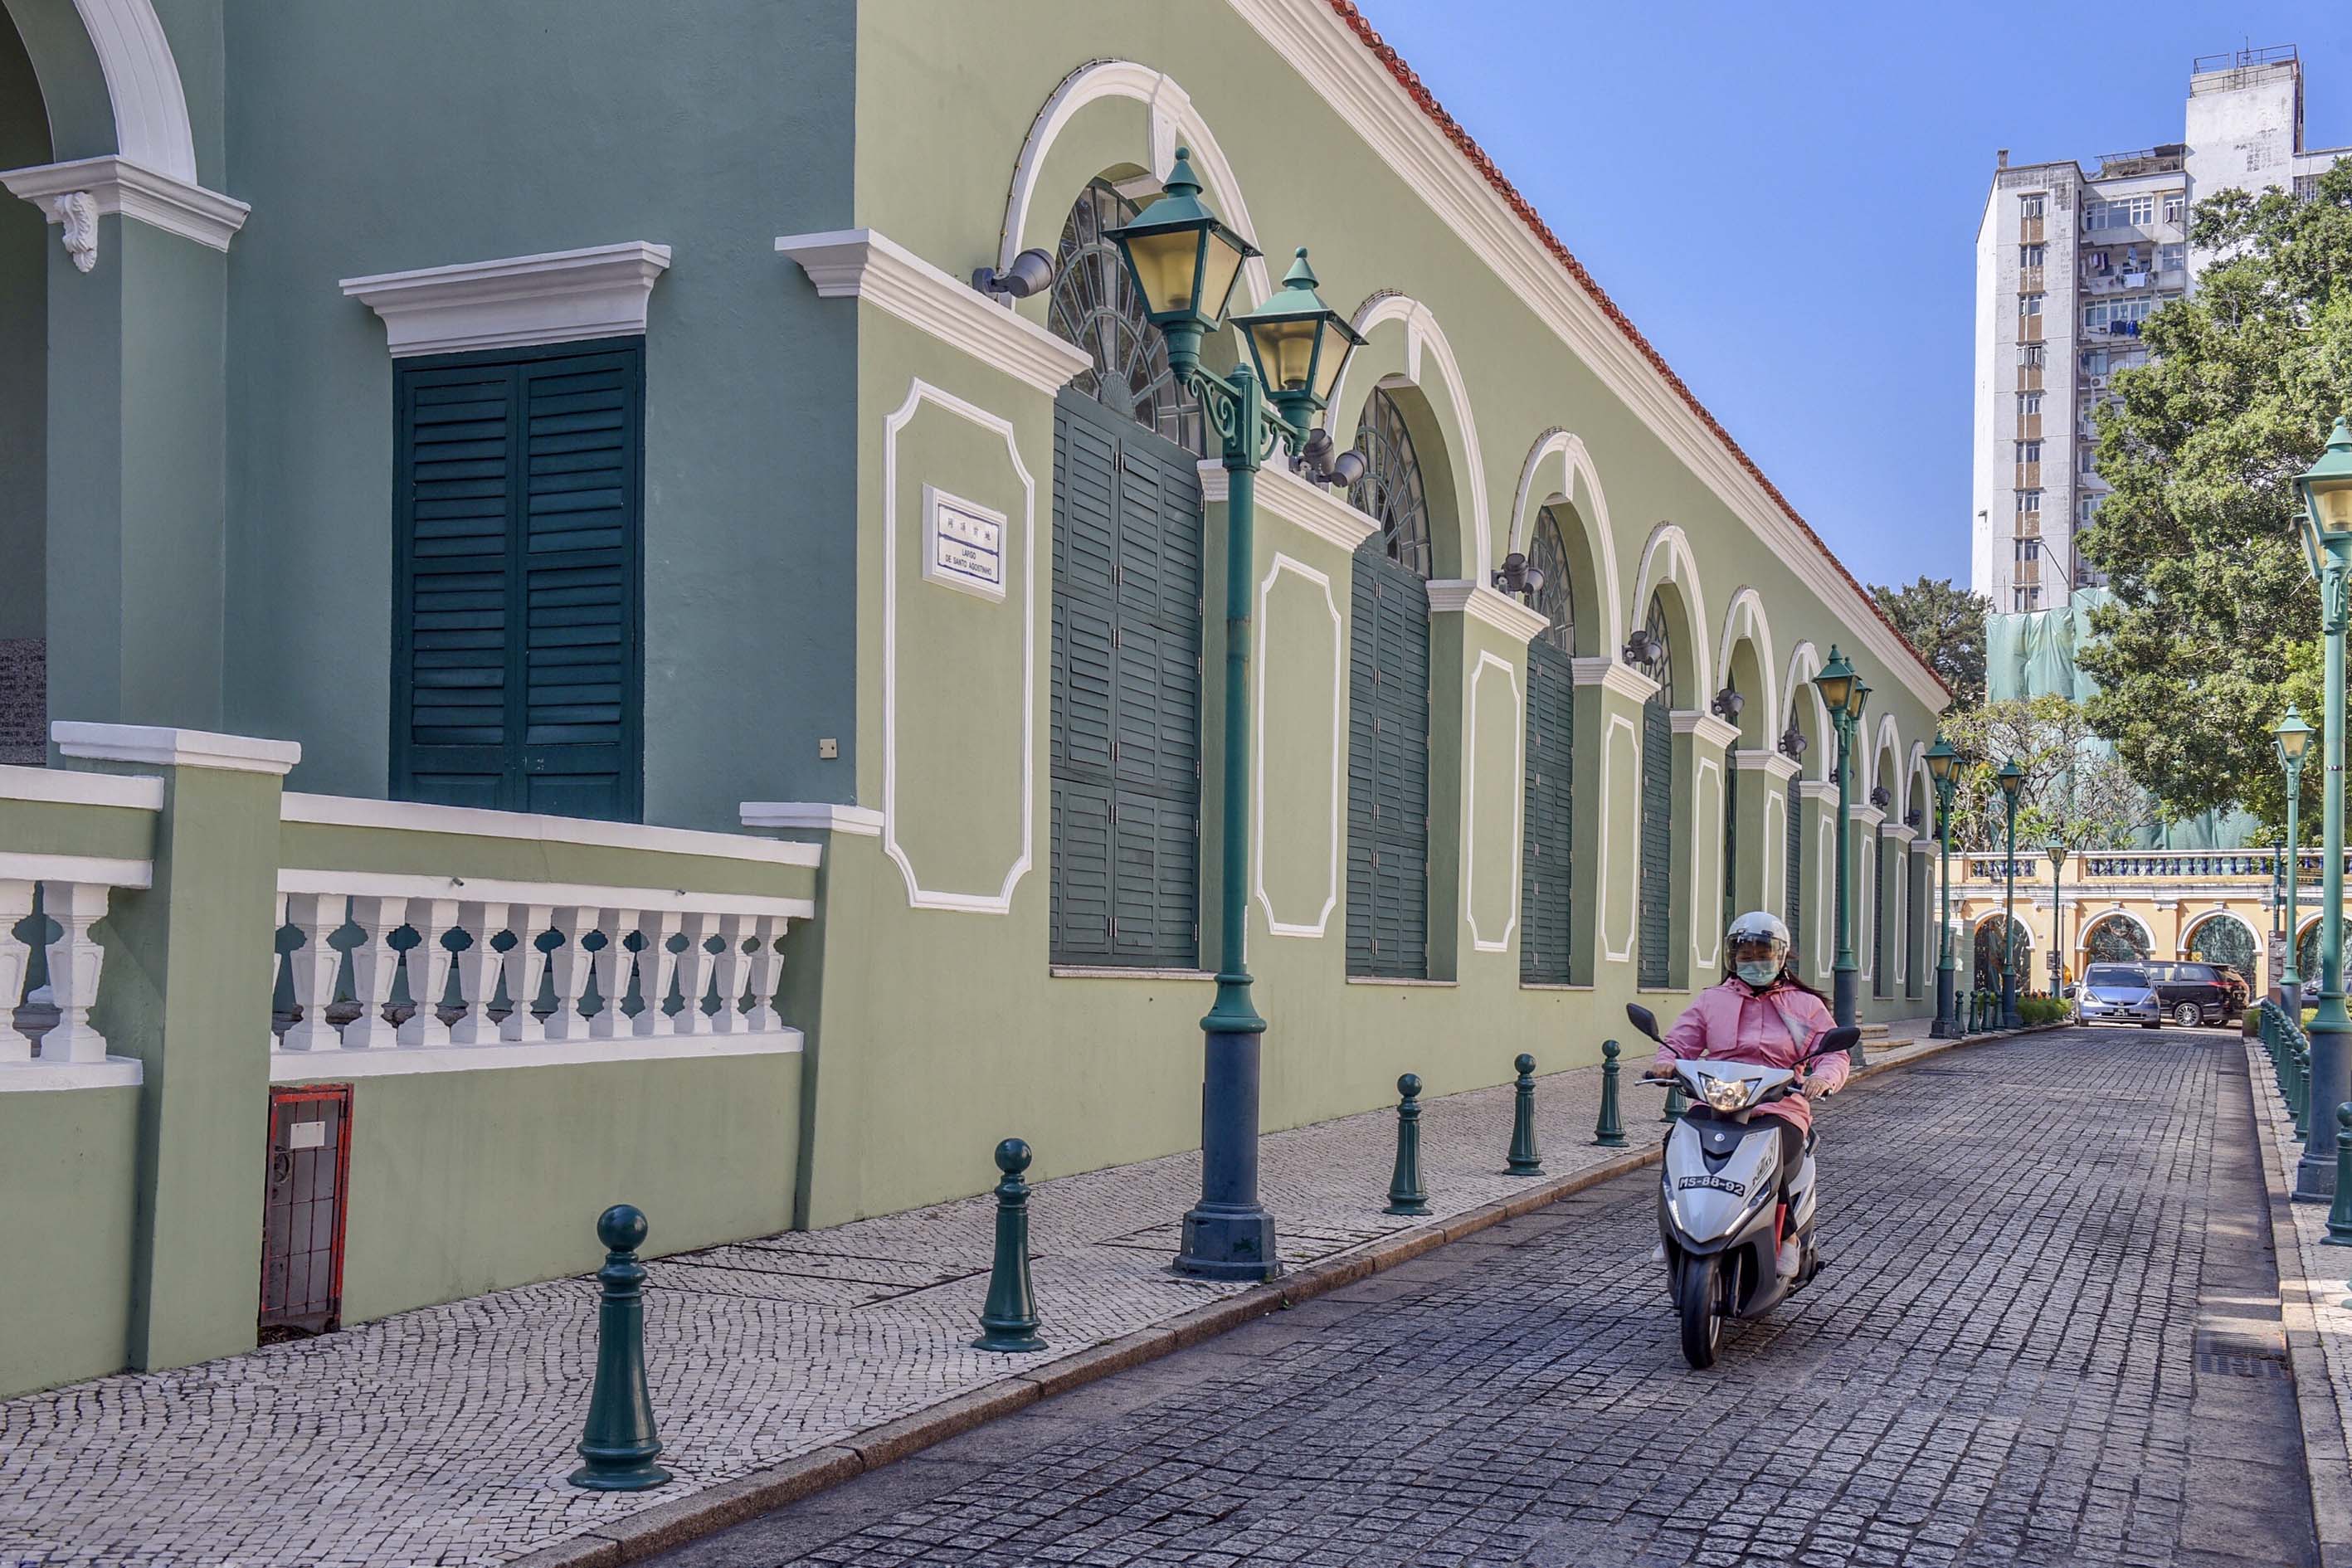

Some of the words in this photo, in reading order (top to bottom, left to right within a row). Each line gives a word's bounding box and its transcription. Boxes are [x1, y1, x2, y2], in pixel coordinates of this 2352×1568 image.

[962, 548, 976, 560] LARGO
[945, 553, 952, 563] DE
[953, 557, 967, 568] SANTO
[969, 562, 992, 576] AGOSTINHO
[1679, 1176, 1745, 1195] MS-88-92
